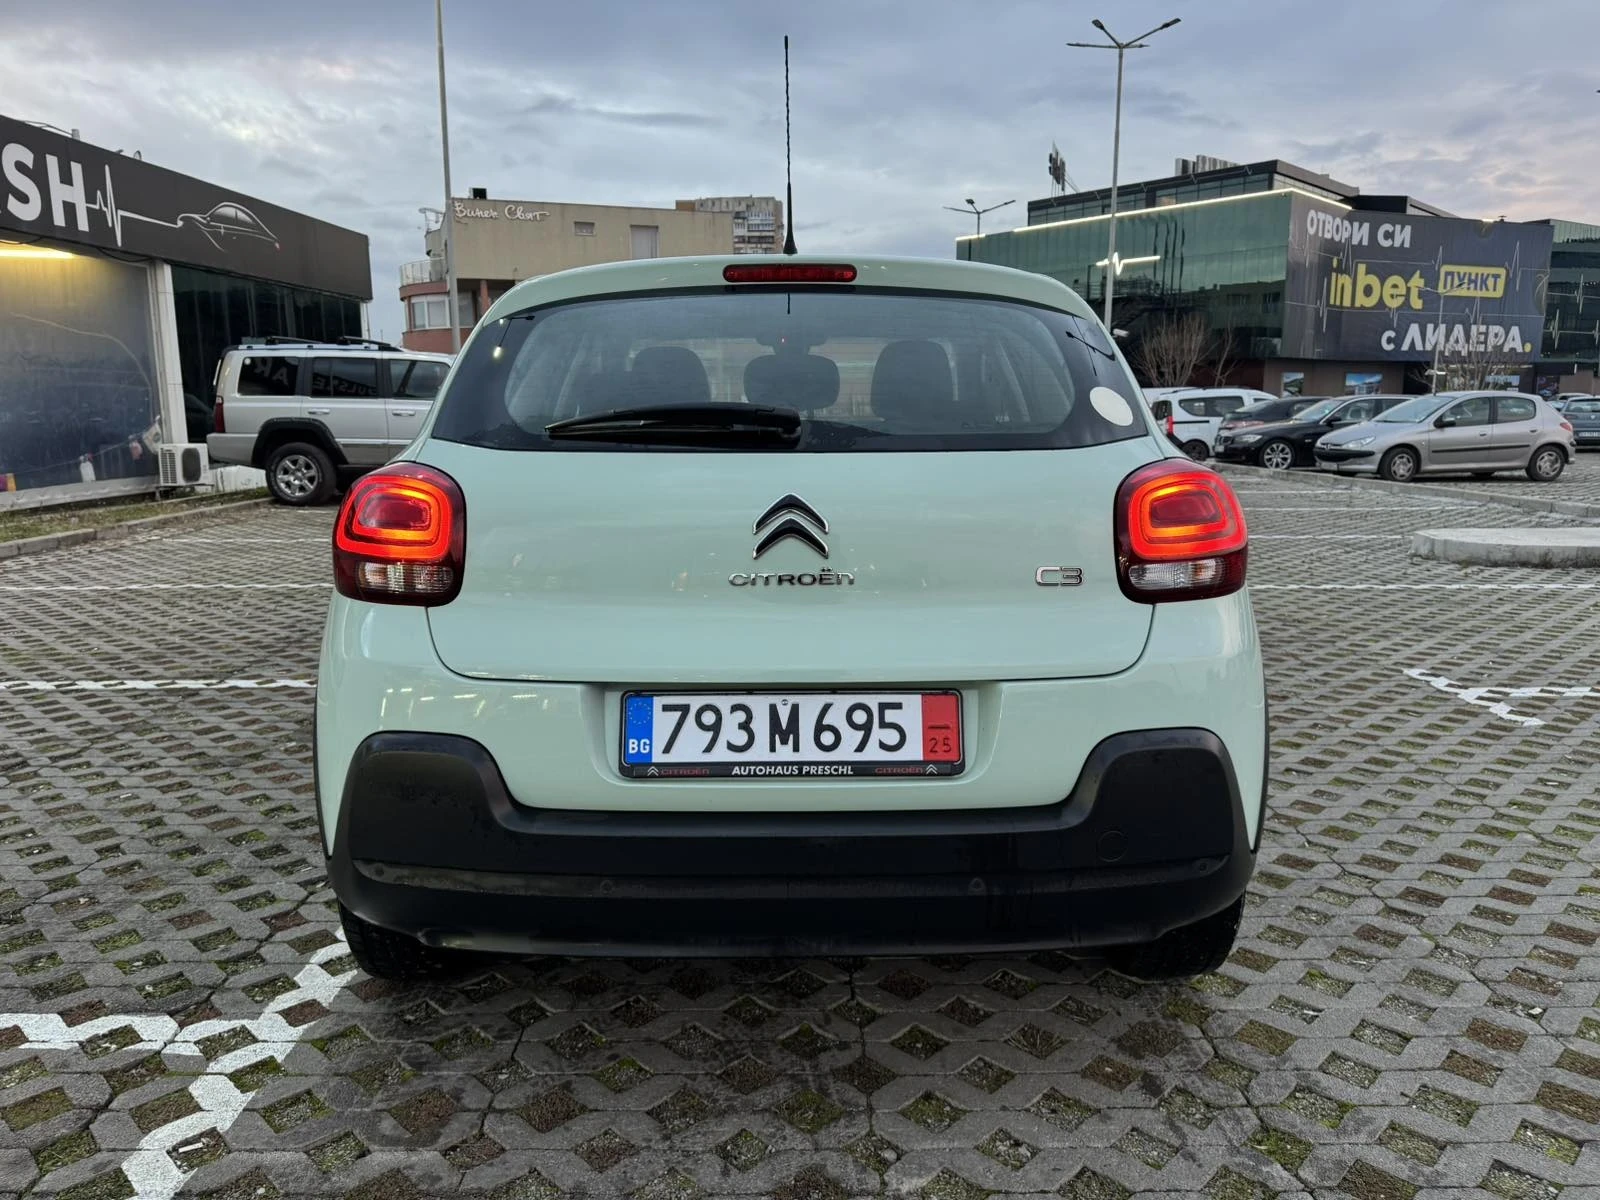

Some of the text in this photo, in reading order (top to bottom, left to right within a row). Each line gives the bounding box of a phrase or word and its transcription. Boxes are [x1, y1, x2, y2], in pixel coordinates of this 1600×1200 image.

[0, 142, 90, 232] SH
[1306, 210, 1412, 248] ОТВОРИ СИ
[1329, 257, 1425, 310] inbet
[1443, 270, 1502, 293] ПУНКТ
[1035, 566, 1084, 586] C3
[661, 703, 755, 754] 793
[813, 702, 907, 753] 695
[628, 738, 650, 754] BG
[929, 737, 952, 753] 25
[731, 764, 854, 776] AUTOHAUS PRESCHL
